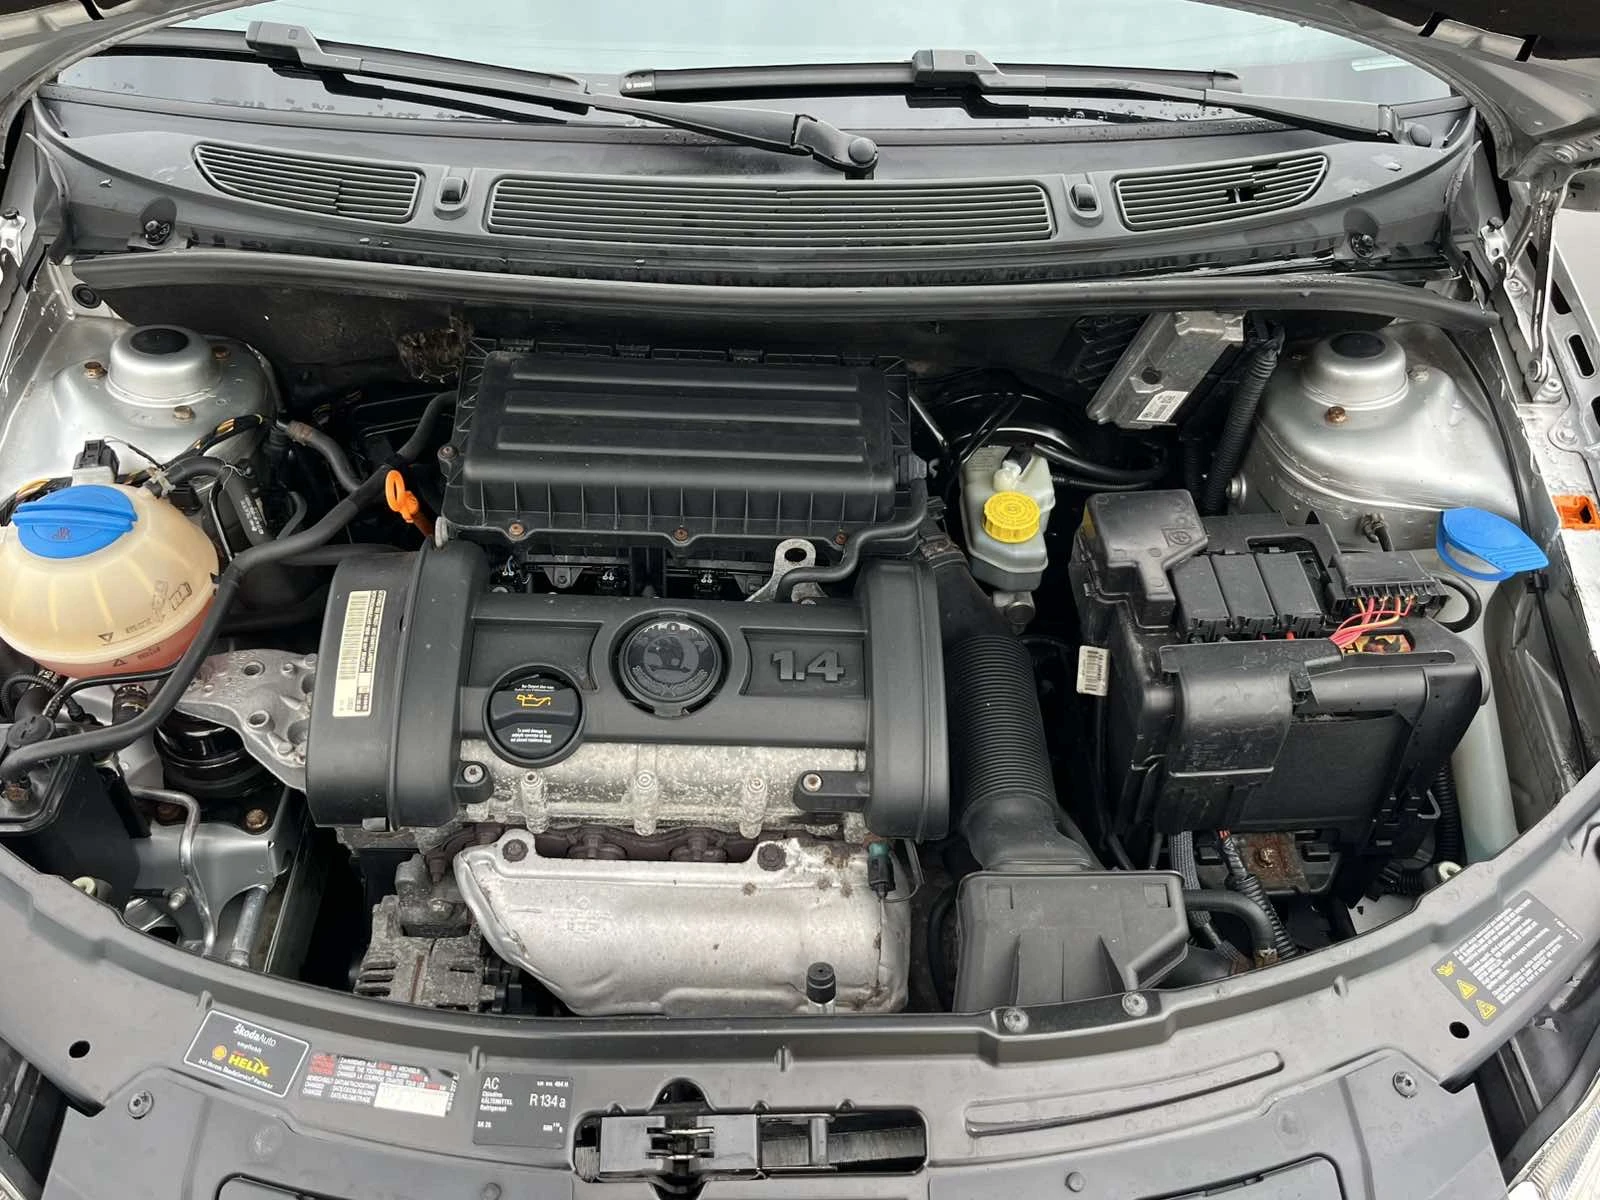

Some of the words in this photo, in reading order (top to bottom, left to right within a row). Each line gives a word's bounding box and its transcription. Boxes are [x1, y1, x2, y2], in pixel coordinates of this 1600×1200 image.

[772, 650, 844, 681] 1.4
[228, 1054, 271, 1077] HELIX
[483, 1077, 500, 1090] AC
